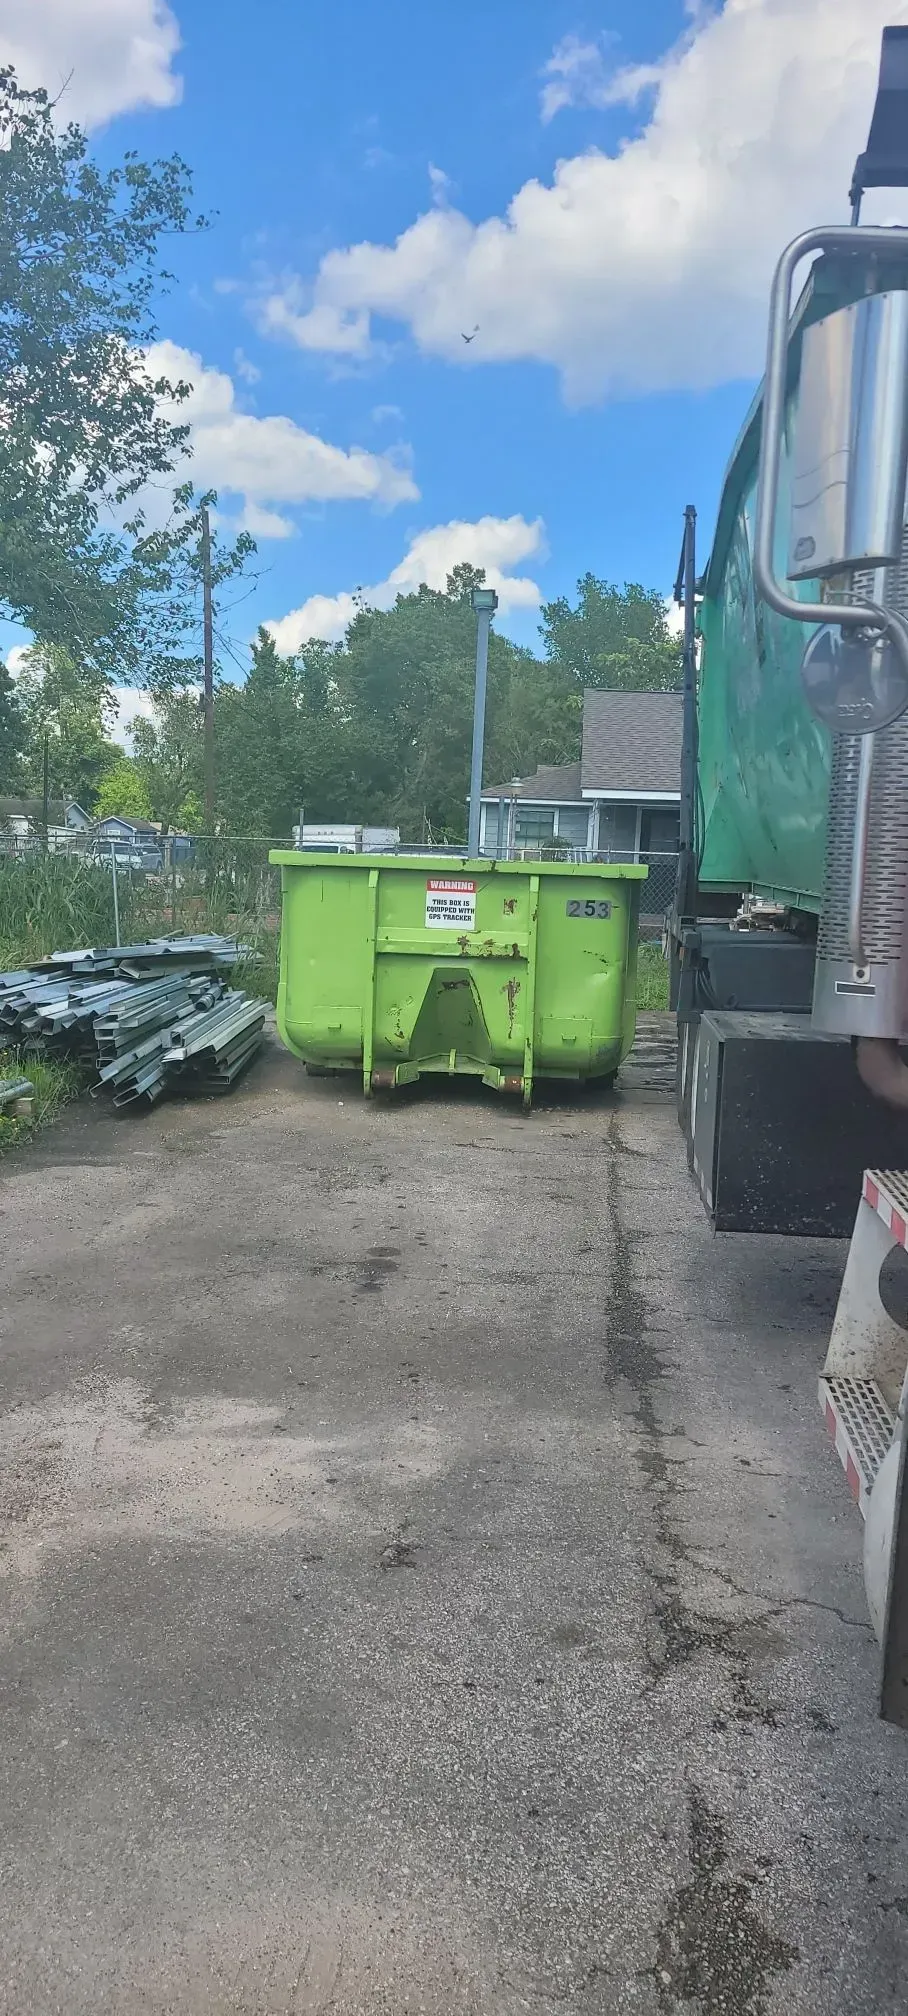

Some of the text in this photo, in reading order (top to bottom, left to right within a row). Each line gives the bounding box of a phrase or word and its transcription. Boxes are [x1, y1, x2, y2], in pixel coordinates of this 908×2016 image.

[430, 880, 474, 890] WARNING
[426, 906, 475, 915] EQUIPPED WITH
[568, 899, 609, 920] 253
